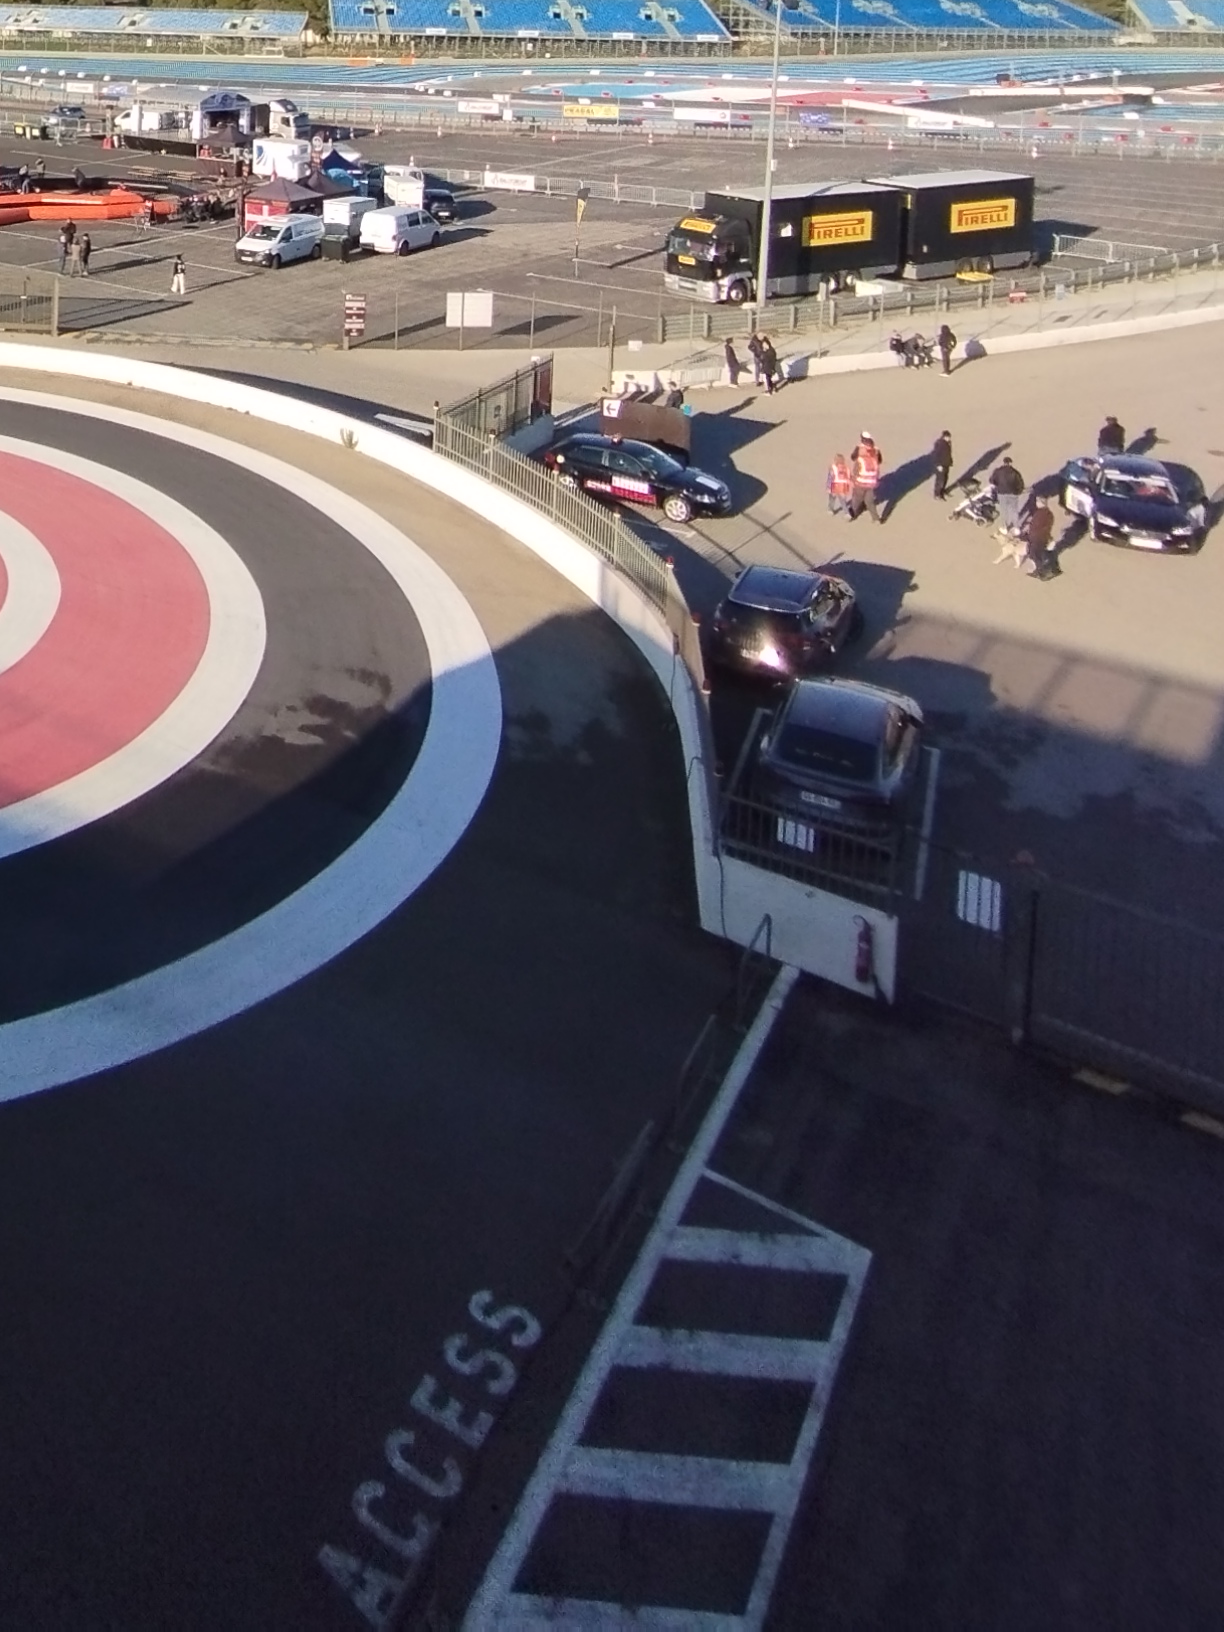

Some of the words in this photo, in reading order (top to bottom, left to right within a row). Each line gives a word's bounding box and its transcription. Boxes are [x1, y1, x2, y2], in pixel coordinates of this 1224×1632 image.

[957, 205, 1008, 227] PIRELLI
[809, 218, 865, 240] PIRELLI
[318, 1289, 543, 1630] ACCESS
